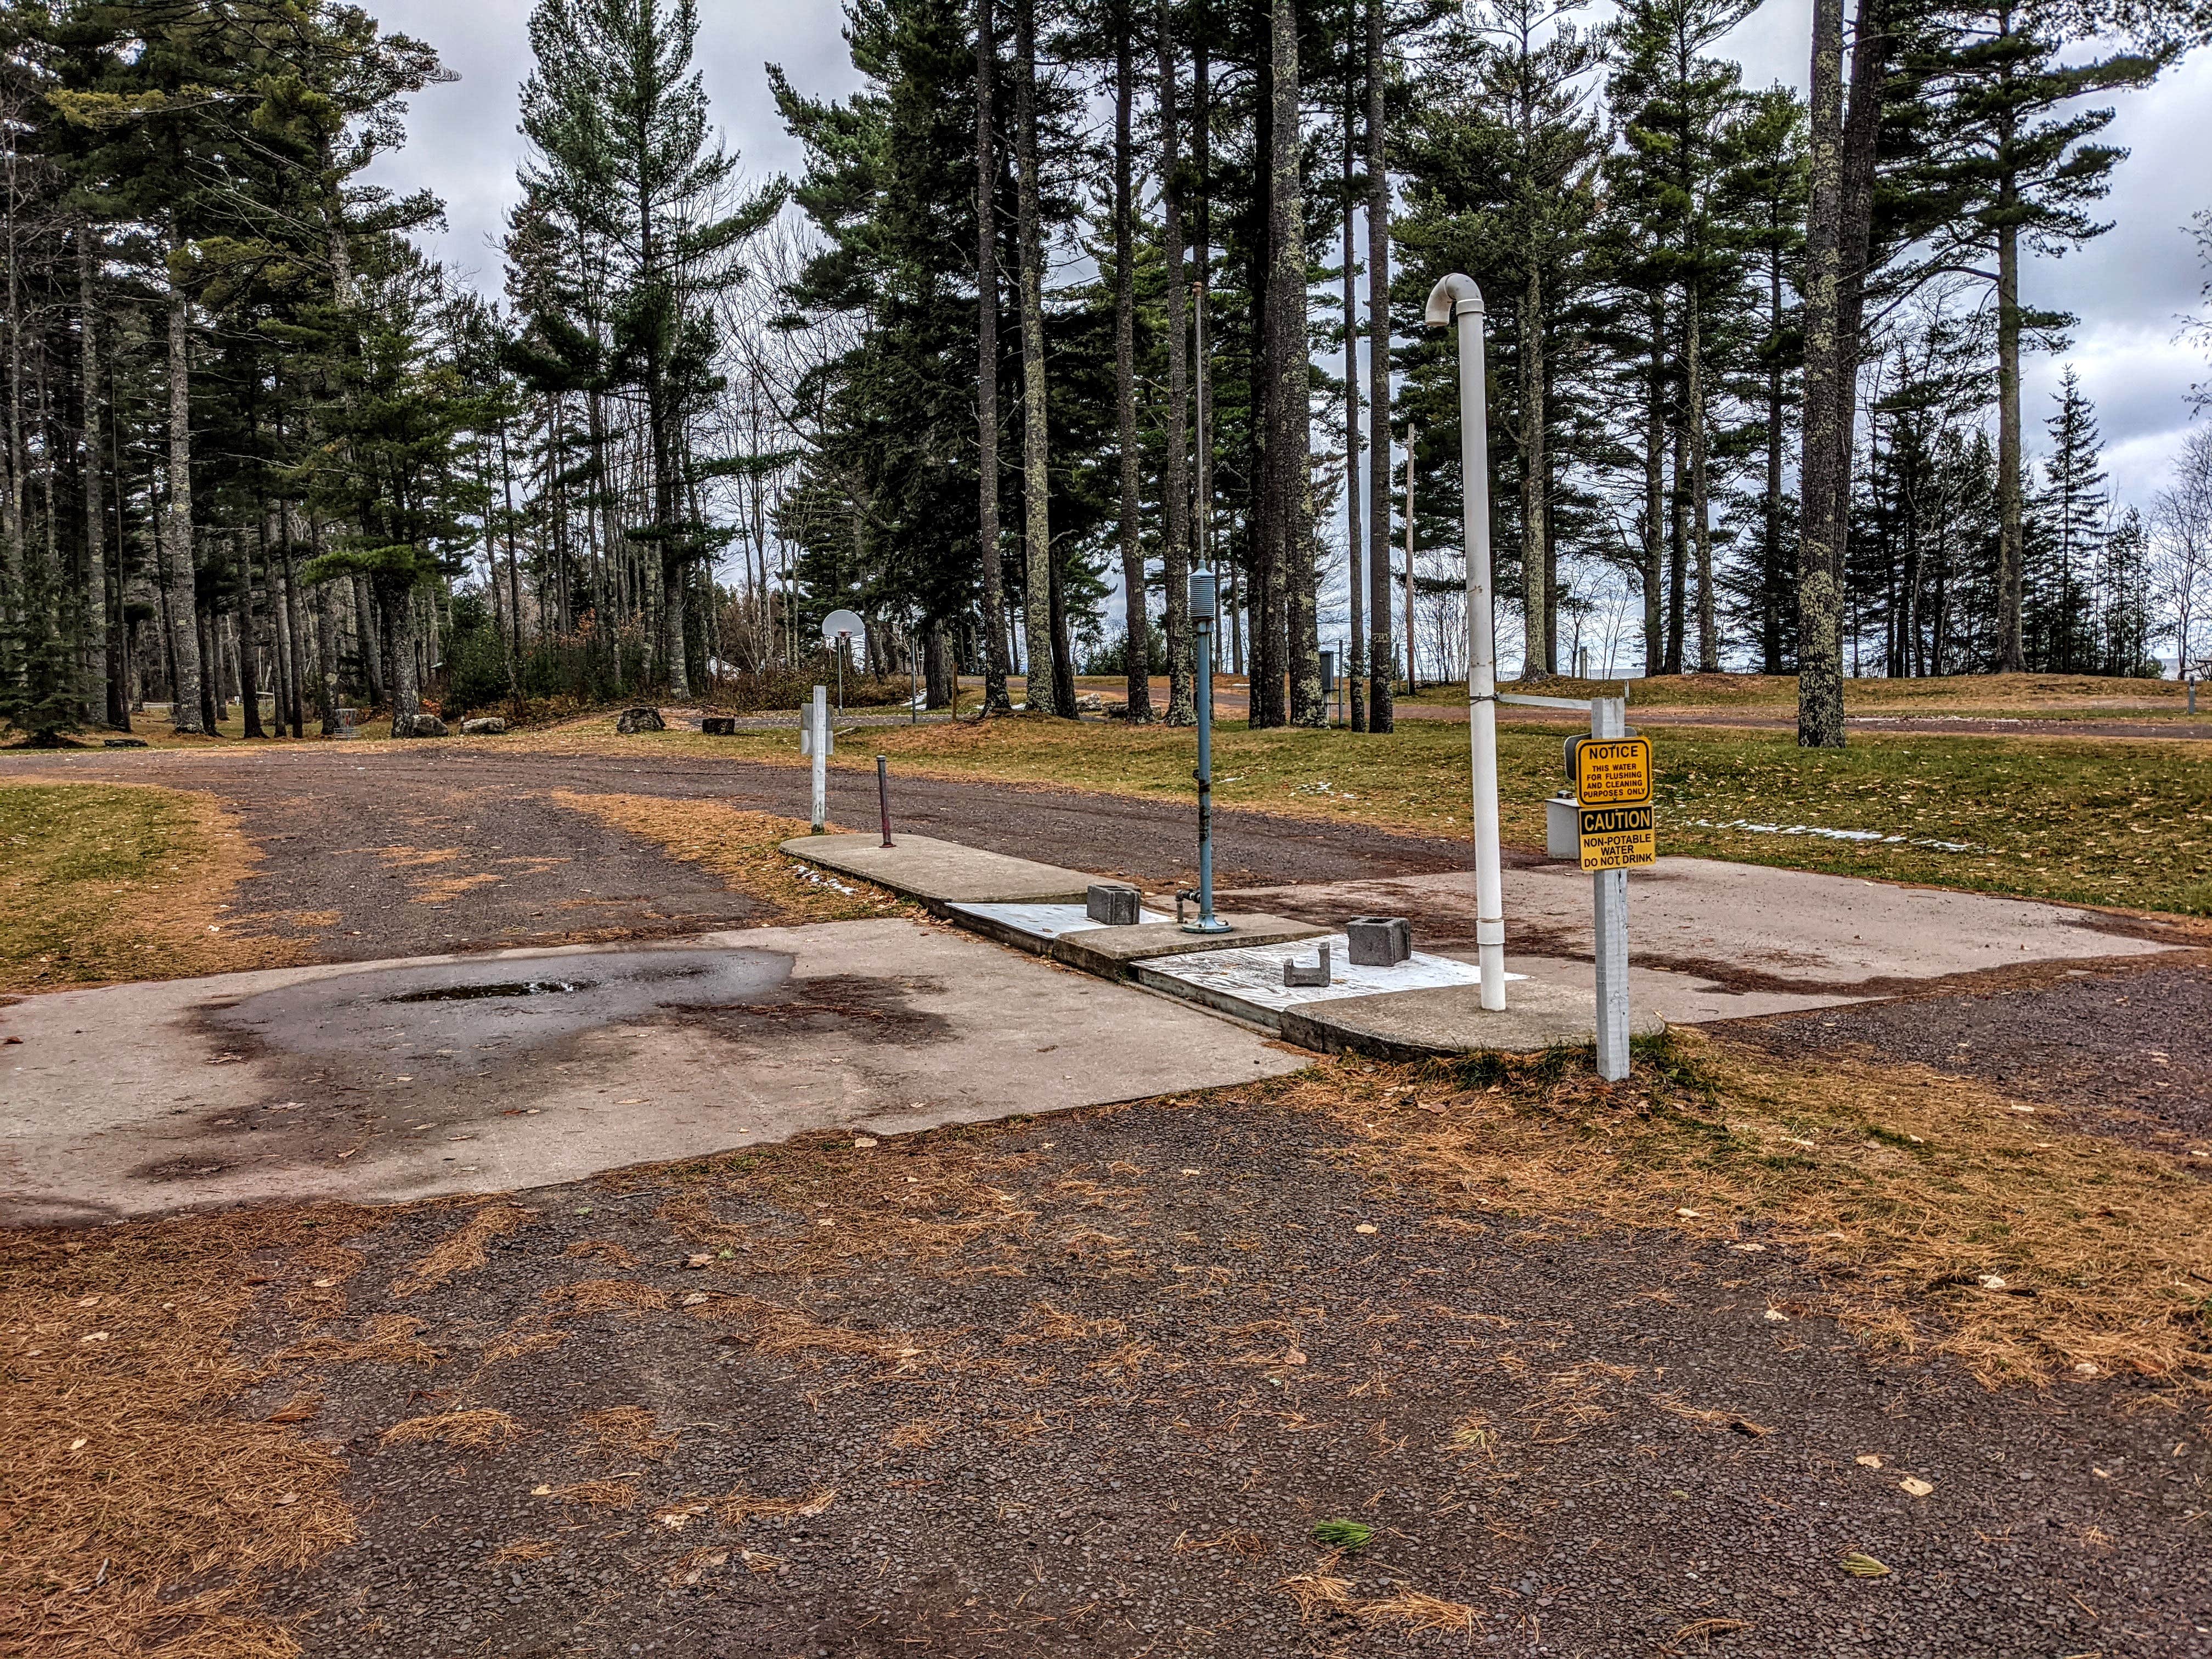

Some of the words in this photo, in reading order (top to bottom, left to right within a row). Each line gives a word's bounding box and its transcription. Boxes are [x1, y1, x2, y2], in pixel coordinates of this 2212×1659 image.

[1589, 746, 1638, 759] NOTICE
[1606, 771, 1641, 780] FLUSHING
[1584, 789, 1623, 798] PURPOSES
[1584, 810, 1650, 831] CAUTION
[1584, 834, 1651, 848] NON-POTABLE
[1601, 845, 1634, 856] WATER
[1584, 859, 1598, 867] DO
[1601, 856, 1620, 866] NOT
[1623, 853, 1652, 864] DRINK
